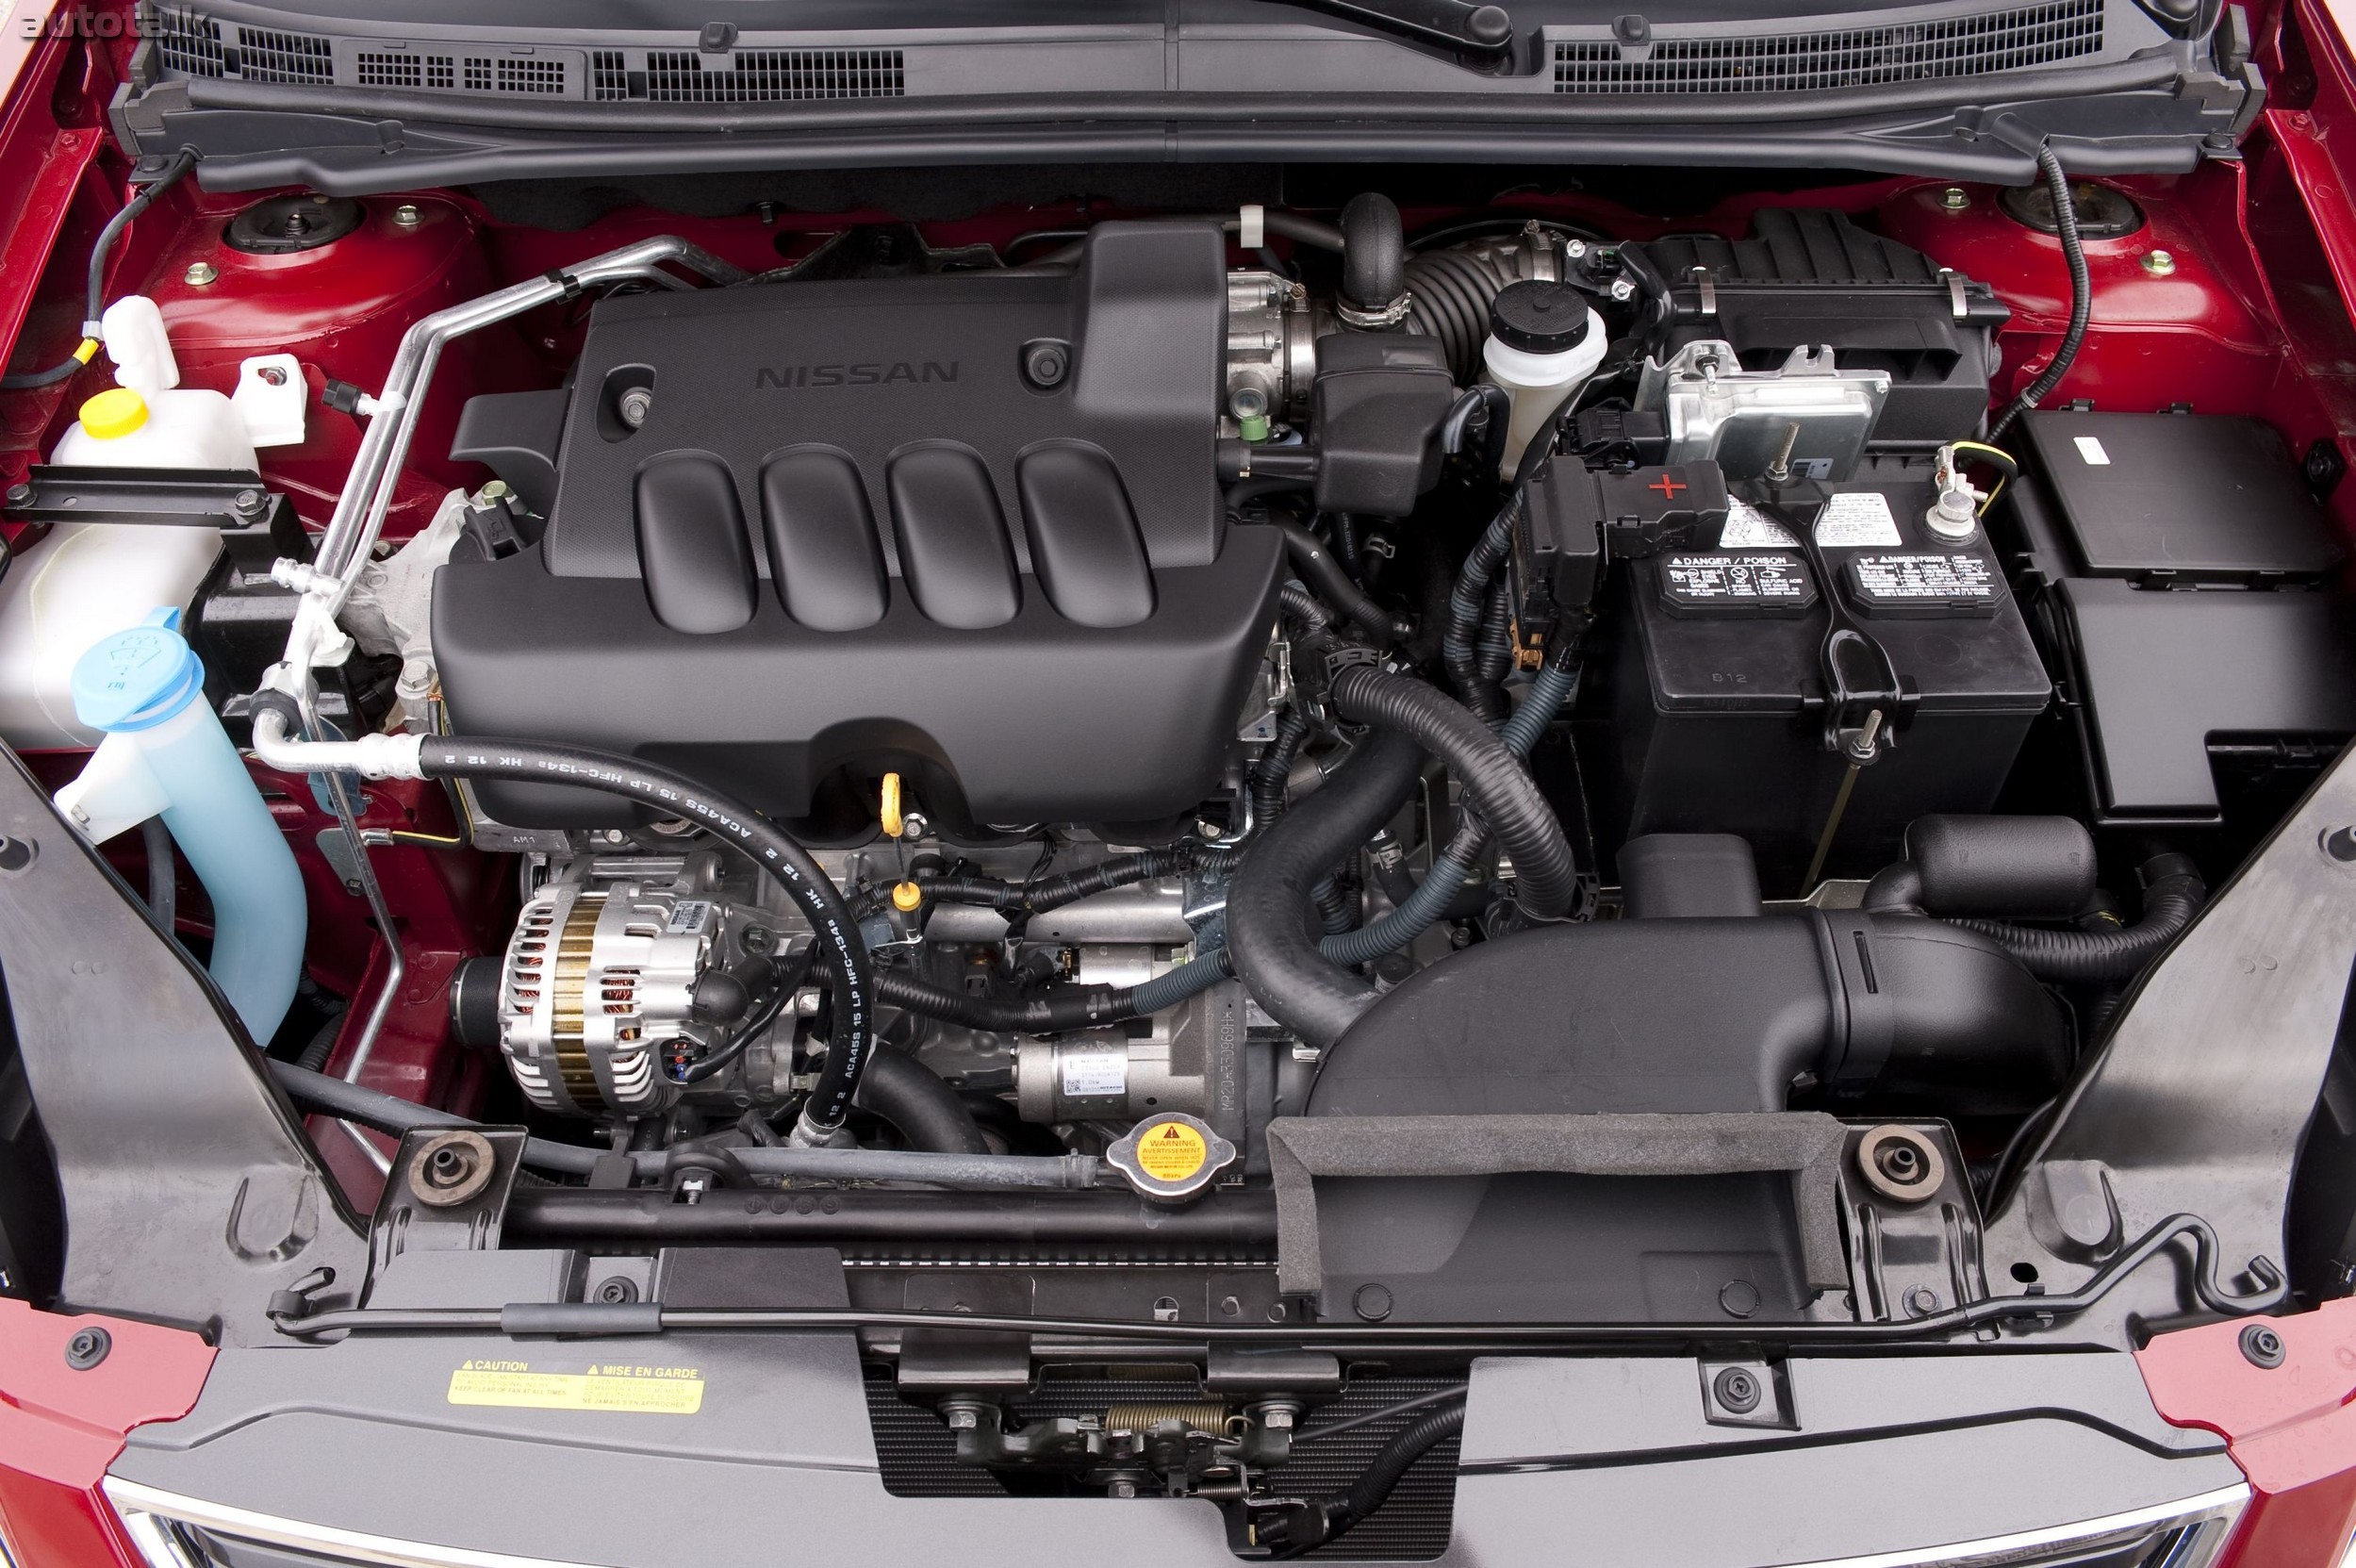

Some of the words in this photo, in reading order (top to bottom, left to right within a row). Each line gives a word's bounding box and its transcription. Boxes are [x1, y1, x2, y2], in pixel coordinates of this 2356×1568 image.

[755, 361, 960, 390] NISSAN
[1683, 557, 1731, 566] DANGER
[1743, 556, 1787, 565] POISON
[445, 755, 456, 764] 2
[468, 755, 487, 765] 12
[499, 756, 522, 767] HK
[537, 760, 622, 784] HFC-134a
[630, 780, 653, 792] LP
[659, 788, 679, 801] 15
[685, 798, 752, 838] ACA45S
[765, 848, 778, 860] 2
[783, 863, 799, 881] 12
[805, 888, 825, 910] HK
[827, 918, 859, 986] HFC-134a
[851, 992, 862, 1007] LP
[853, 1012, 862, 1027] 15
[845, 1032, 862, 1079] ACA45S
[829, 1104, 841, 1116] 12
[474, 1360, 528, 1372] CAUTION
[602, 1365, 632, 1377] MISE
[635, 1366, 655, 1378] EN
[657, 1367, 698, 1379] GARDE
